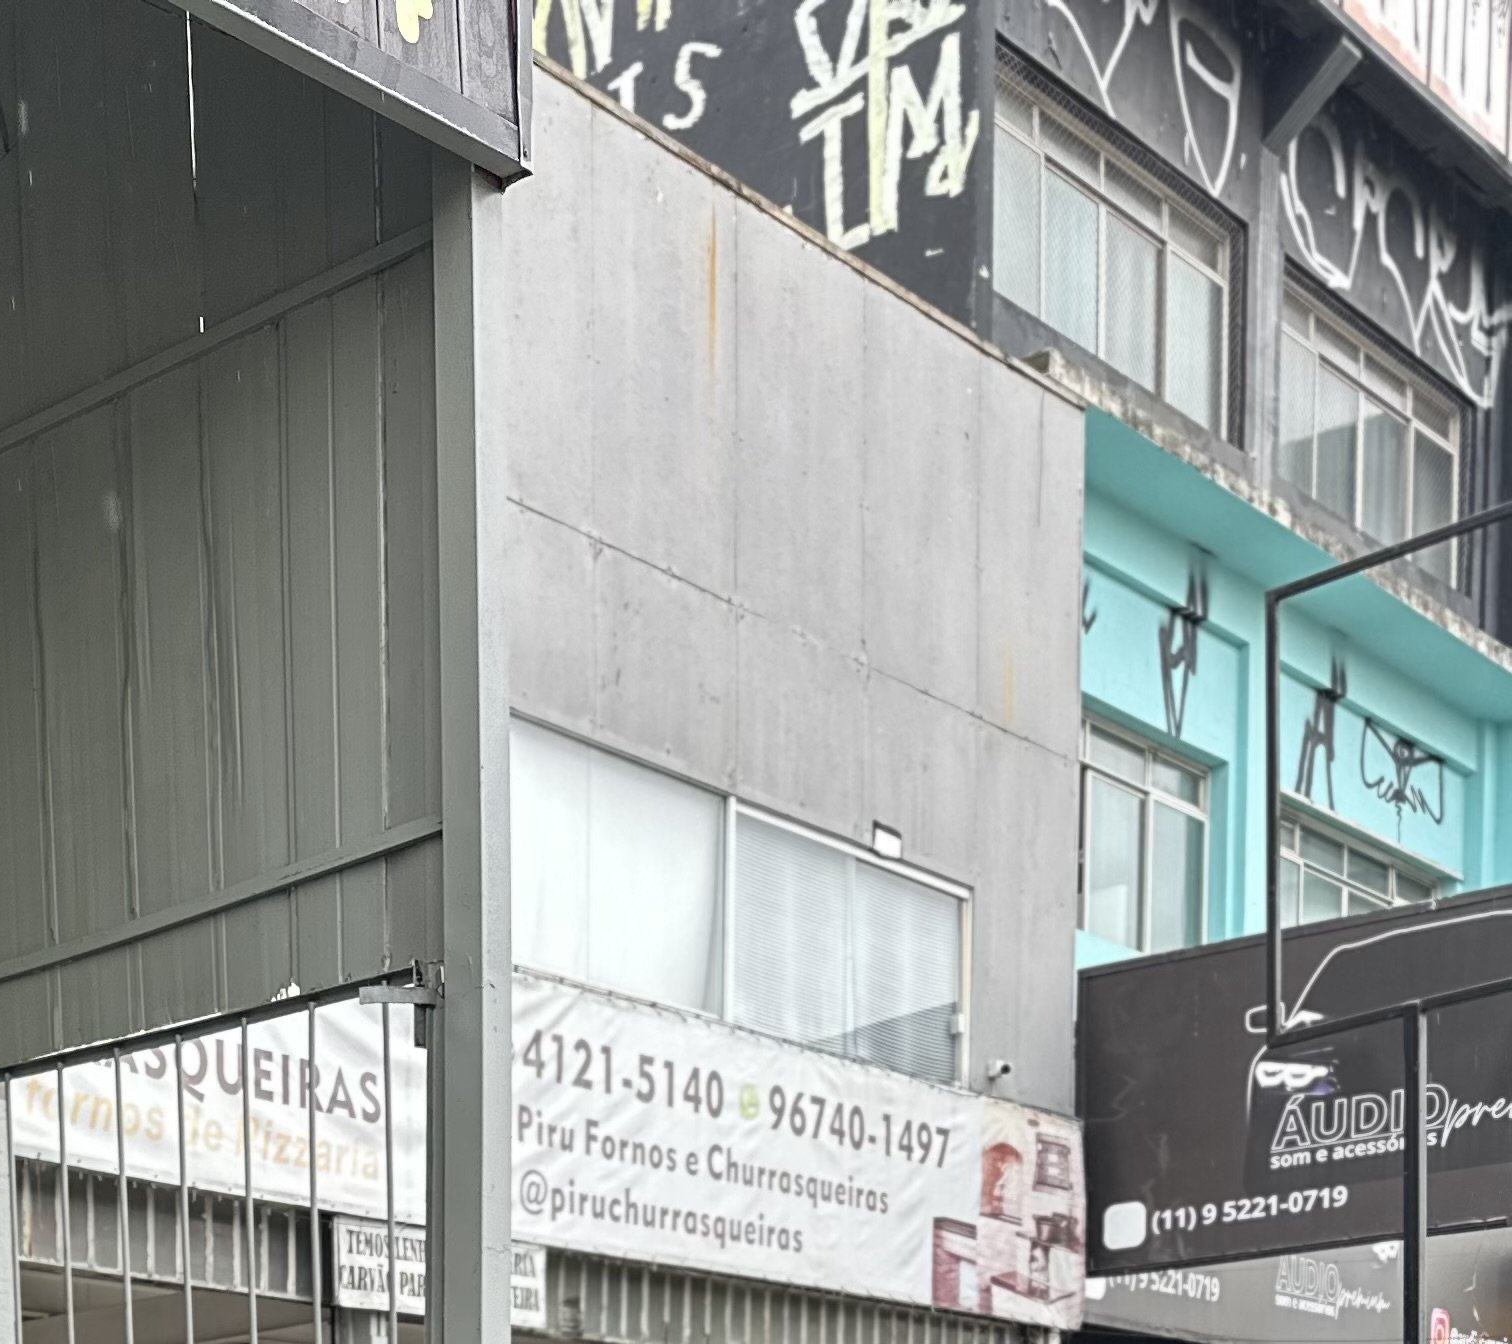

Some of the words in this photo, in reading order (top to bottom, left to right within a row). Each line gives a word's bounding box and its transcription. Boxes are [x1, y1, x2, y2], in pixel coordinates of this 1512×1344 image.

[522, 1028, 725, 1119] 4121-5140
[769, 1084, 951, 1170] 96740-1497
[517, 1104, 574, 1154] Piru
[584, 1119, 677, 1173] Fornos
[687, 1148, 699, 1176] e
[707, 1143, 889, 1214] Churrasqueiras
[1270, 1151, 1312, 1170] som
[1315, 1147, 1328, 1162] e
[519, 1169, 803, 1253] @piruchurrasqueiras
[1151, 1207, 1197, 1235] (11)
[1201, 1203, 1217, 1225] 9
[1222, 1184, 1349, 1223] 5221-0719
